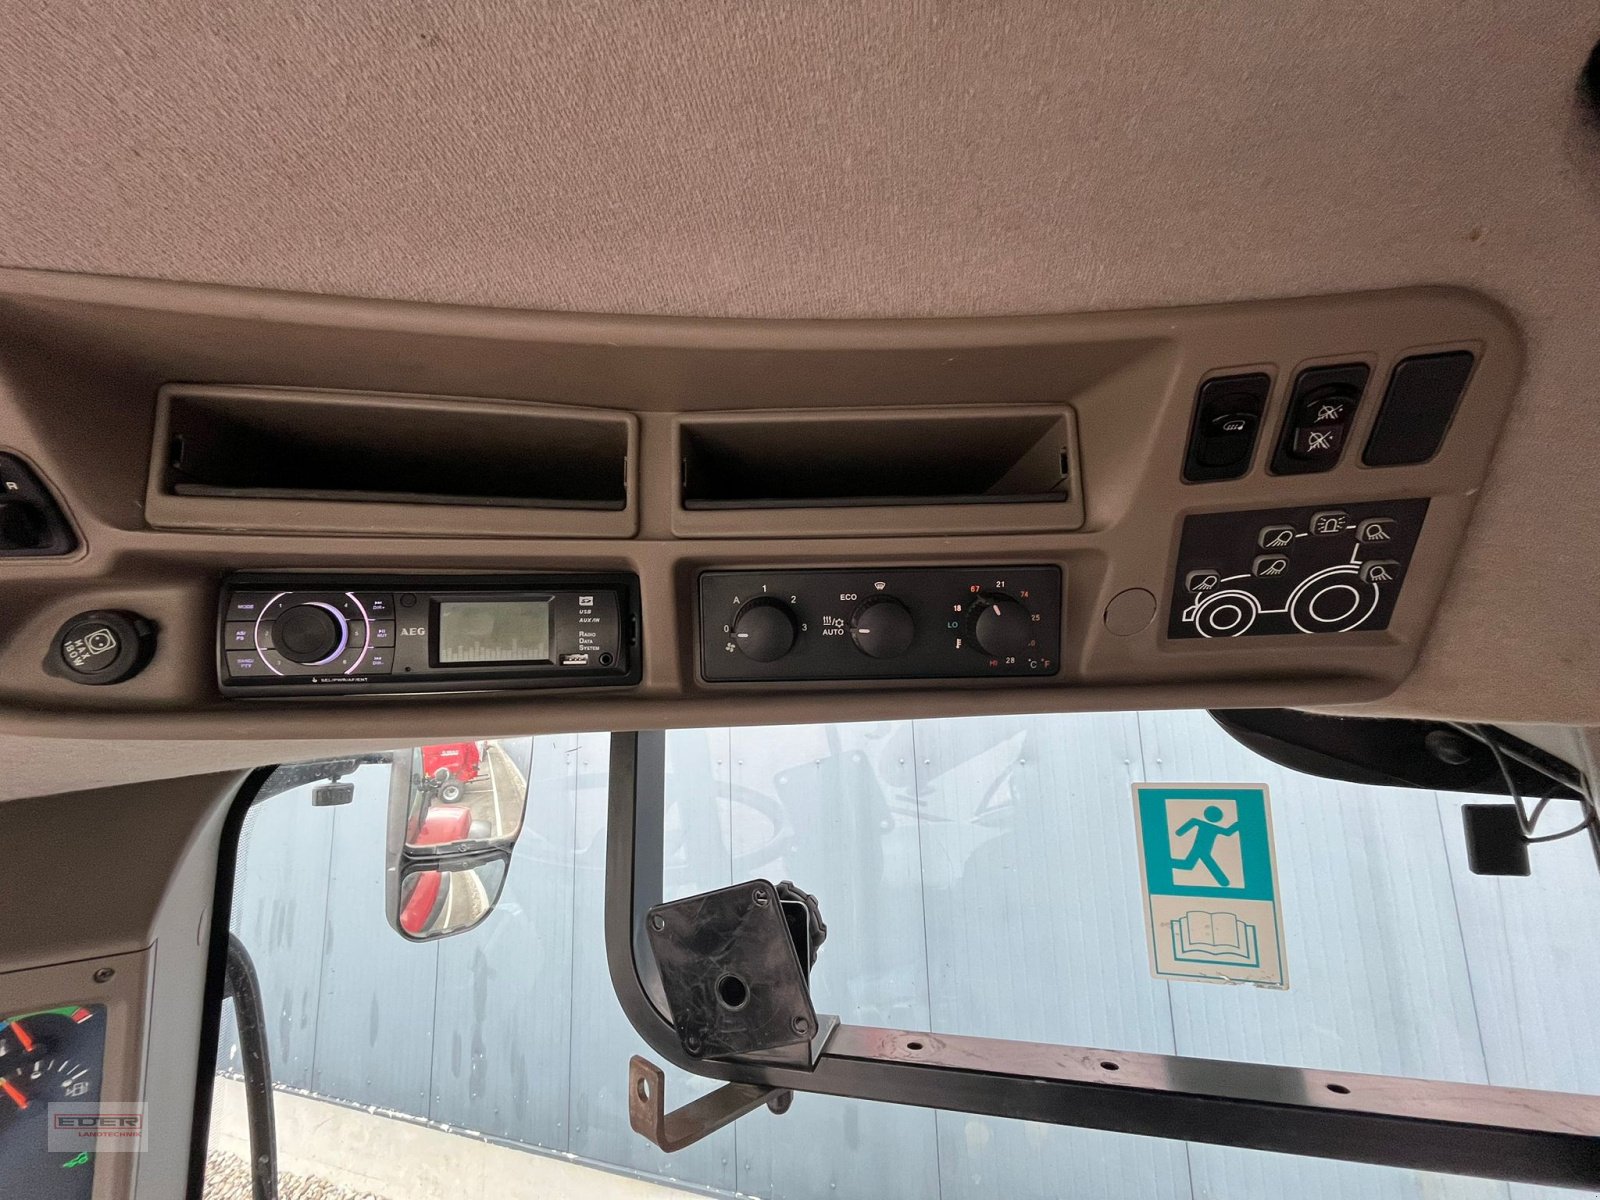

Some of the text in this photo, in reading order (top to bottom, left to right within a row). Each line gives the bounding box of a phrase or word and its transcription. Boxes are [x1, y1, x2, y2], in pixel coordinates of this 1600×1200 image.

[6, 481, 18, 490] R
[995, 580, 1005, 588] 21
[761, 584, 767, 593] 1
[1020, 590, 1029, 598] 74
[790, 595, 797, 603] 2
[953, 604, 962, 612] 18
[723, 625, 730, 633] 0
[802, 624, 808, 632] 3
[947, 621, 959, 629] LO
[401, 627, 426, 636] AEG
[823, 628, 845, 636] AUTO
[74, 639, 91, 660] MAX
[1005, 656, 1015, 664] 28
